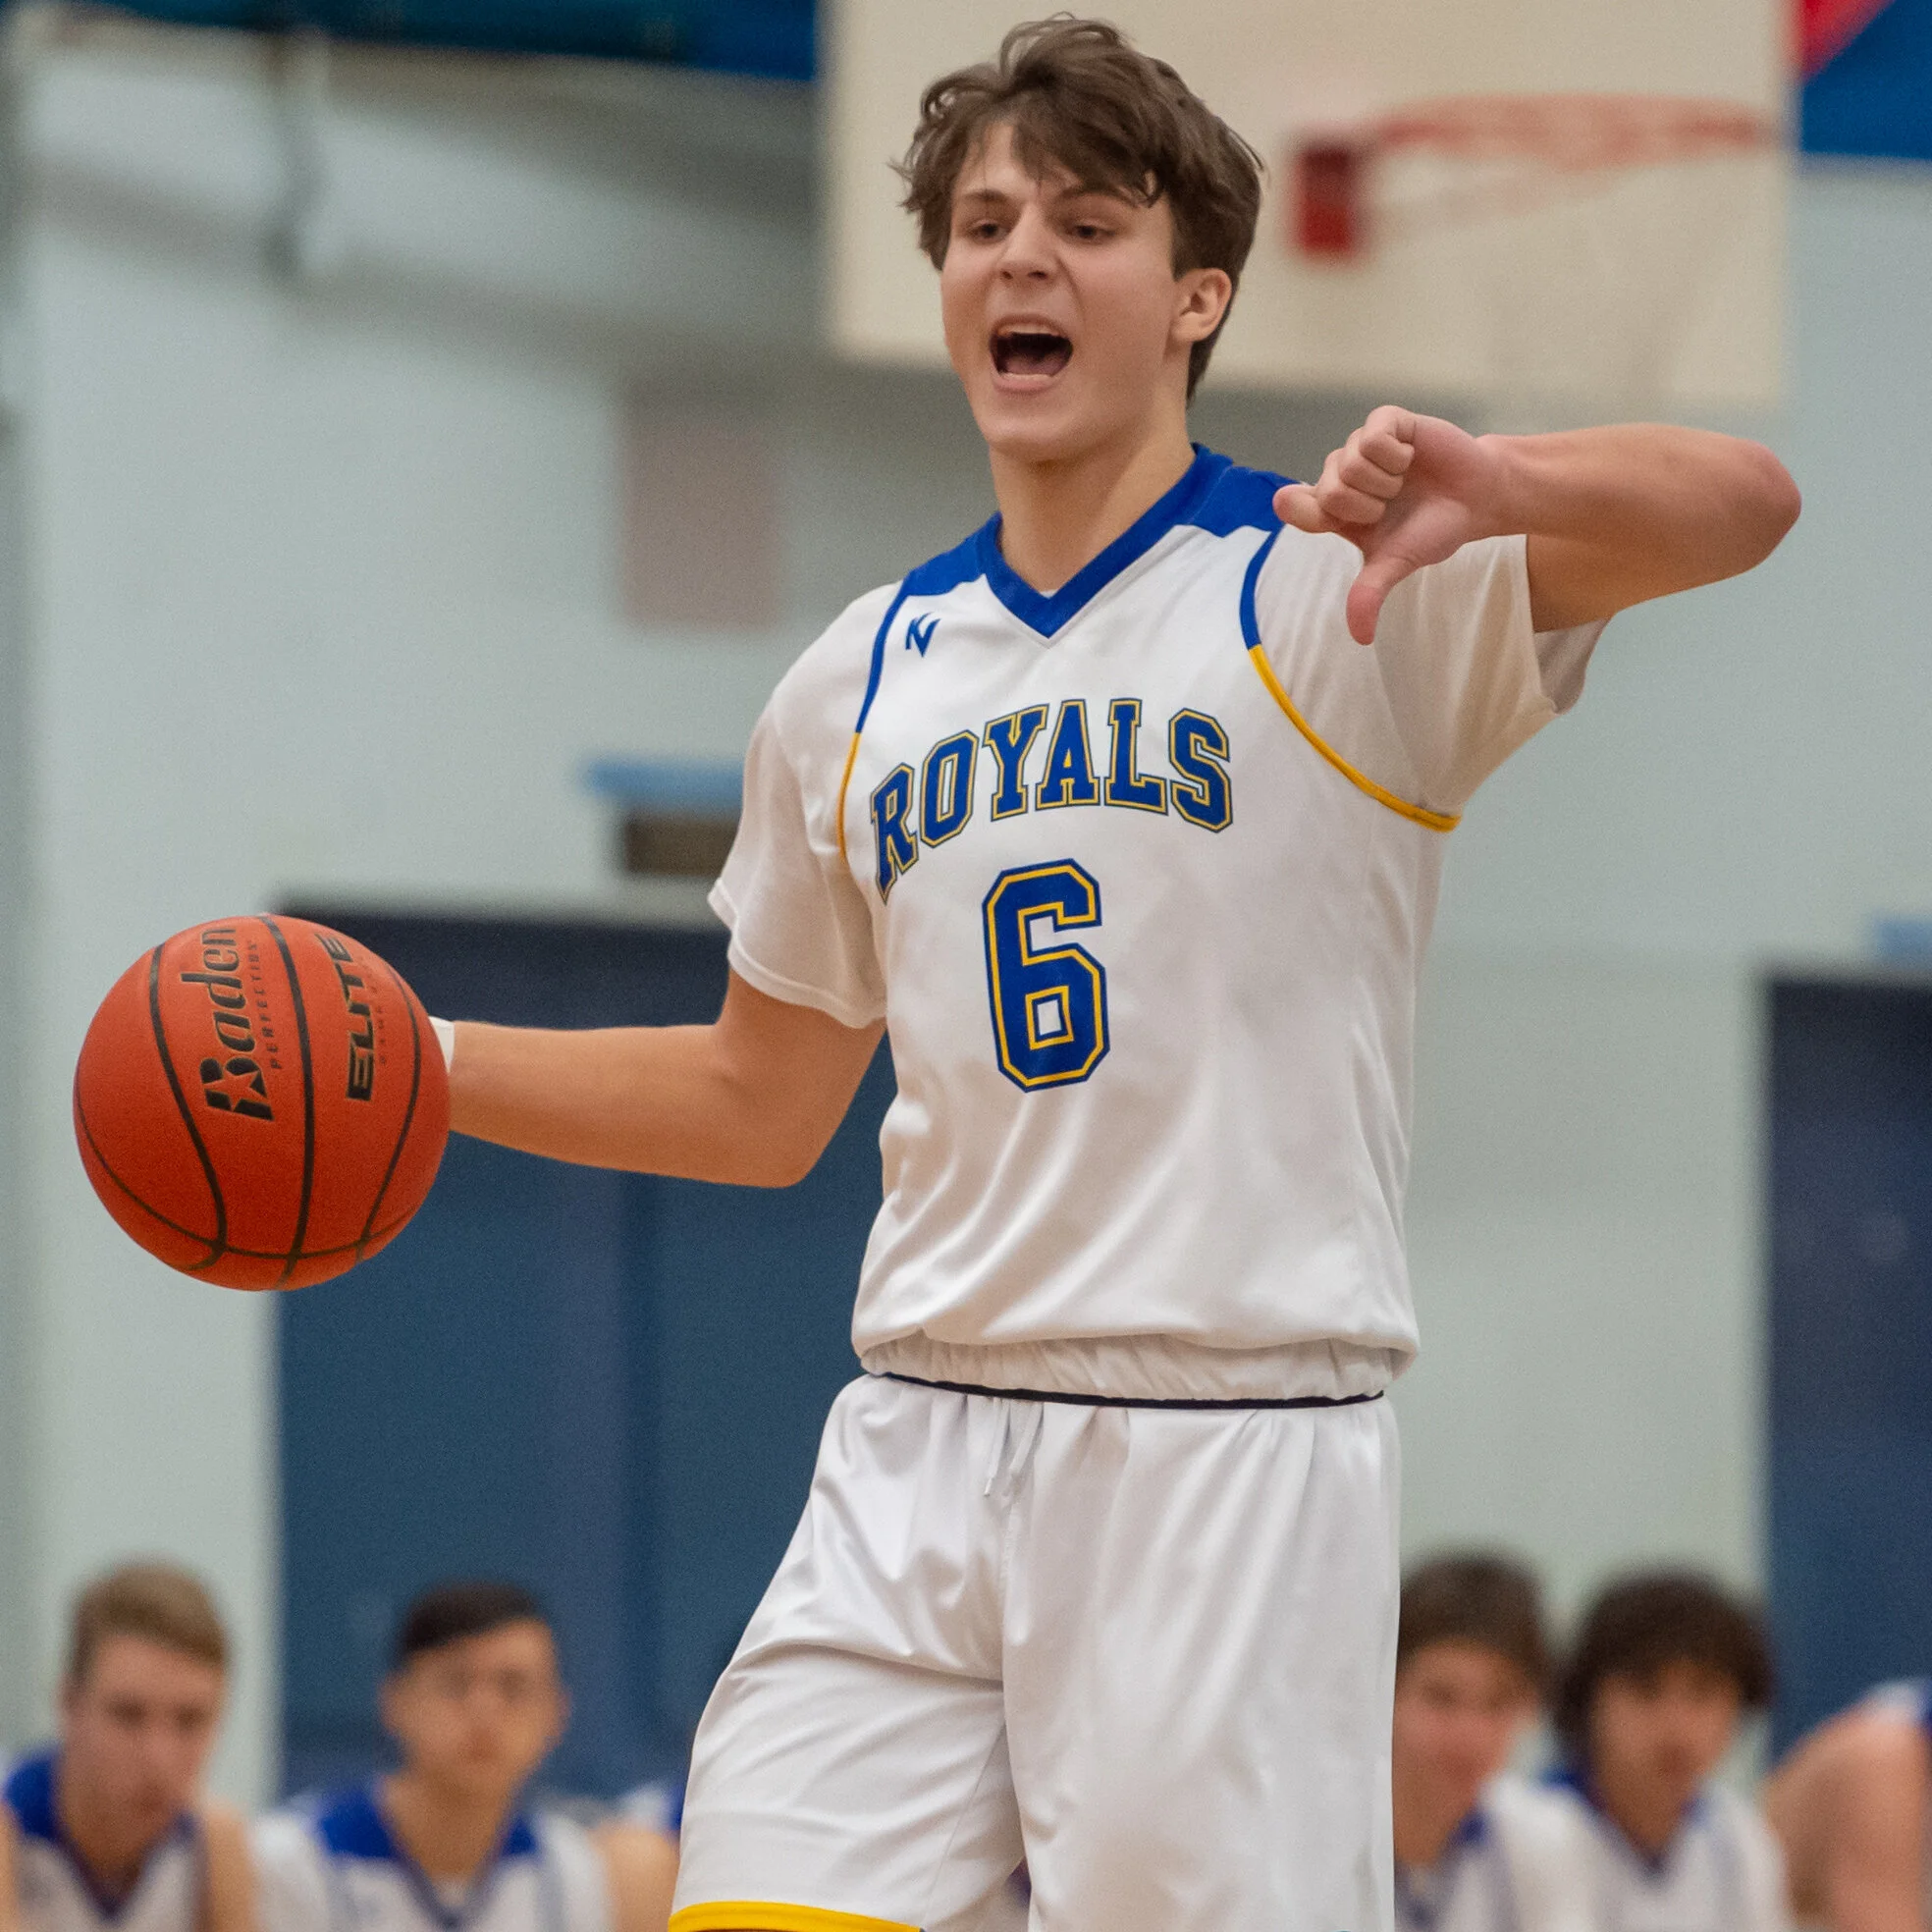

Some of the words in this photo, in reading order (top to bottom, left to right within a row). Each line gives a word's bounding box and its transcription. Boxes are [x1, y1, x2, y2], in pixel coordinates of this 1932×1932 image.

[871, 698, 1233, 905] ROYALS
[180, 929, 274, 1122] Baden
[314, 934, 374, 1101] ELITE
[983, 859, 1110, 1092] 6
